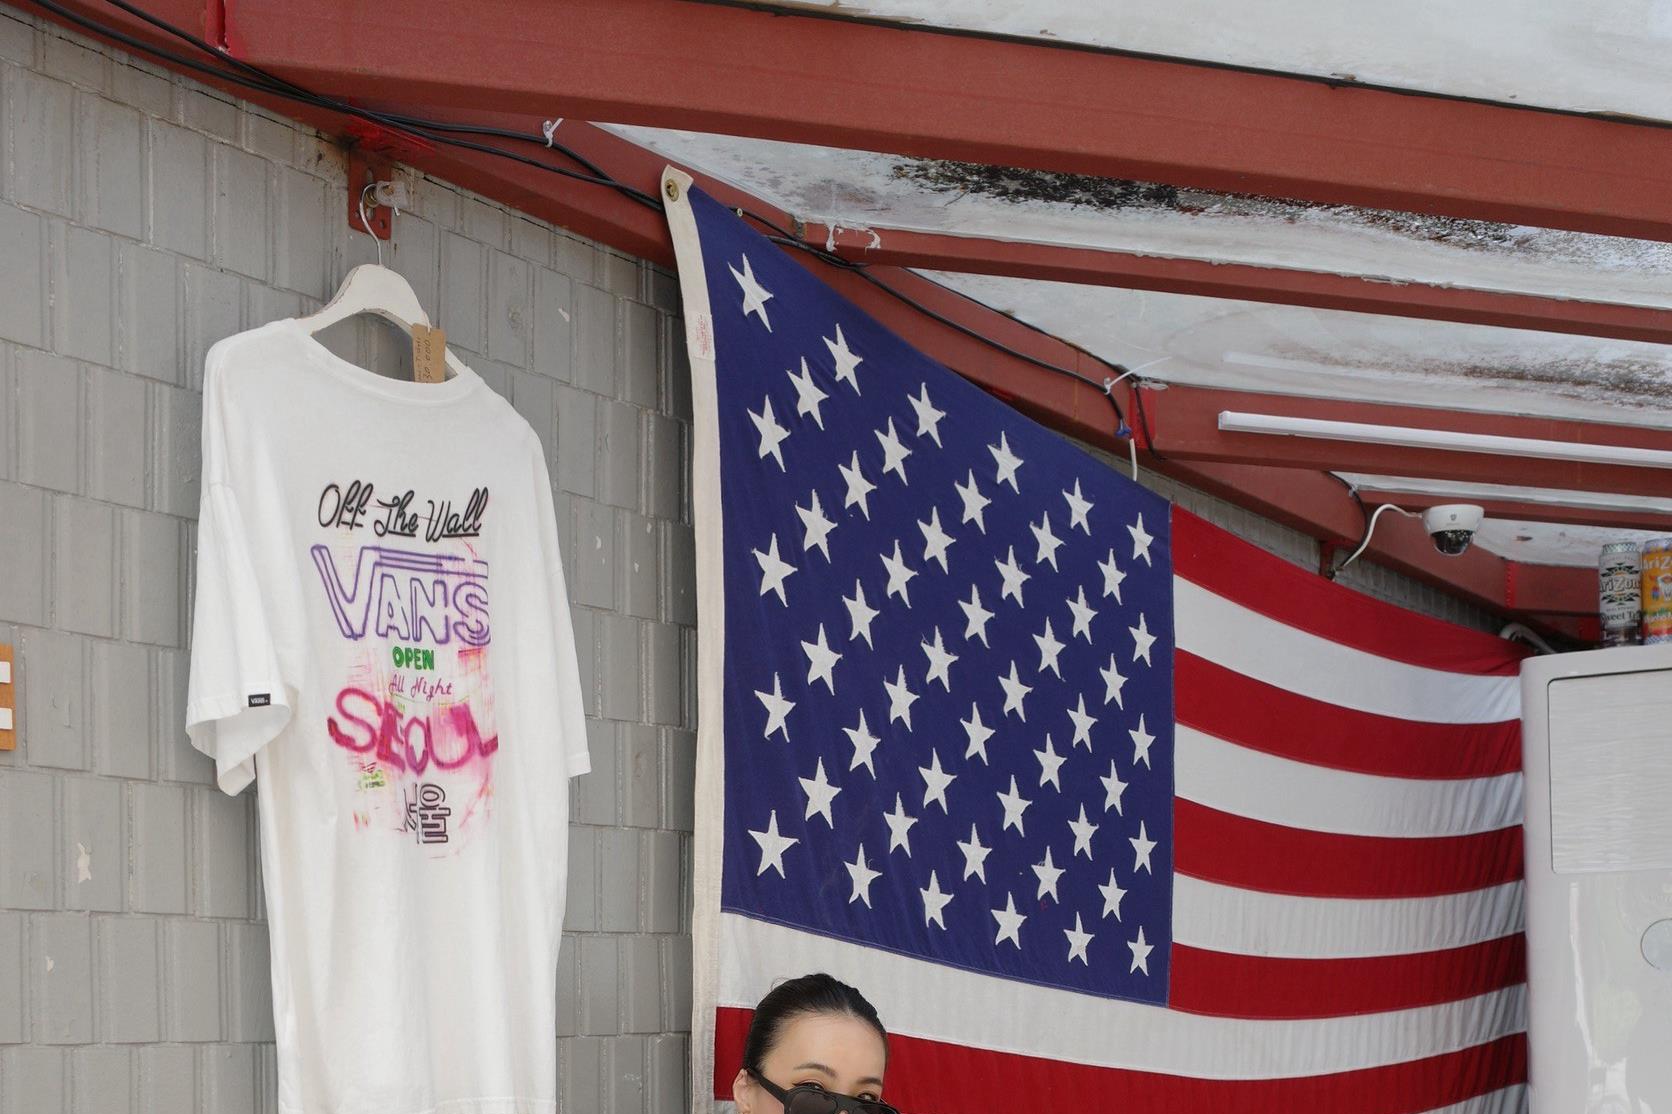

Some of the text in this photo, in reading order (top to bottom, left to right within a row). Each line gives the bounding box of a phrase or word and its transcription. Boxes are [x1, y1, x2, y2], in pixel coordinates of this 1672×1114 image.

[318, 480, 489, 542] Off The Wall
[310, 544, 491, 646] VANS
[392, 646, 435, 671] OPEN
[389, 673, 453, 702] All Night
